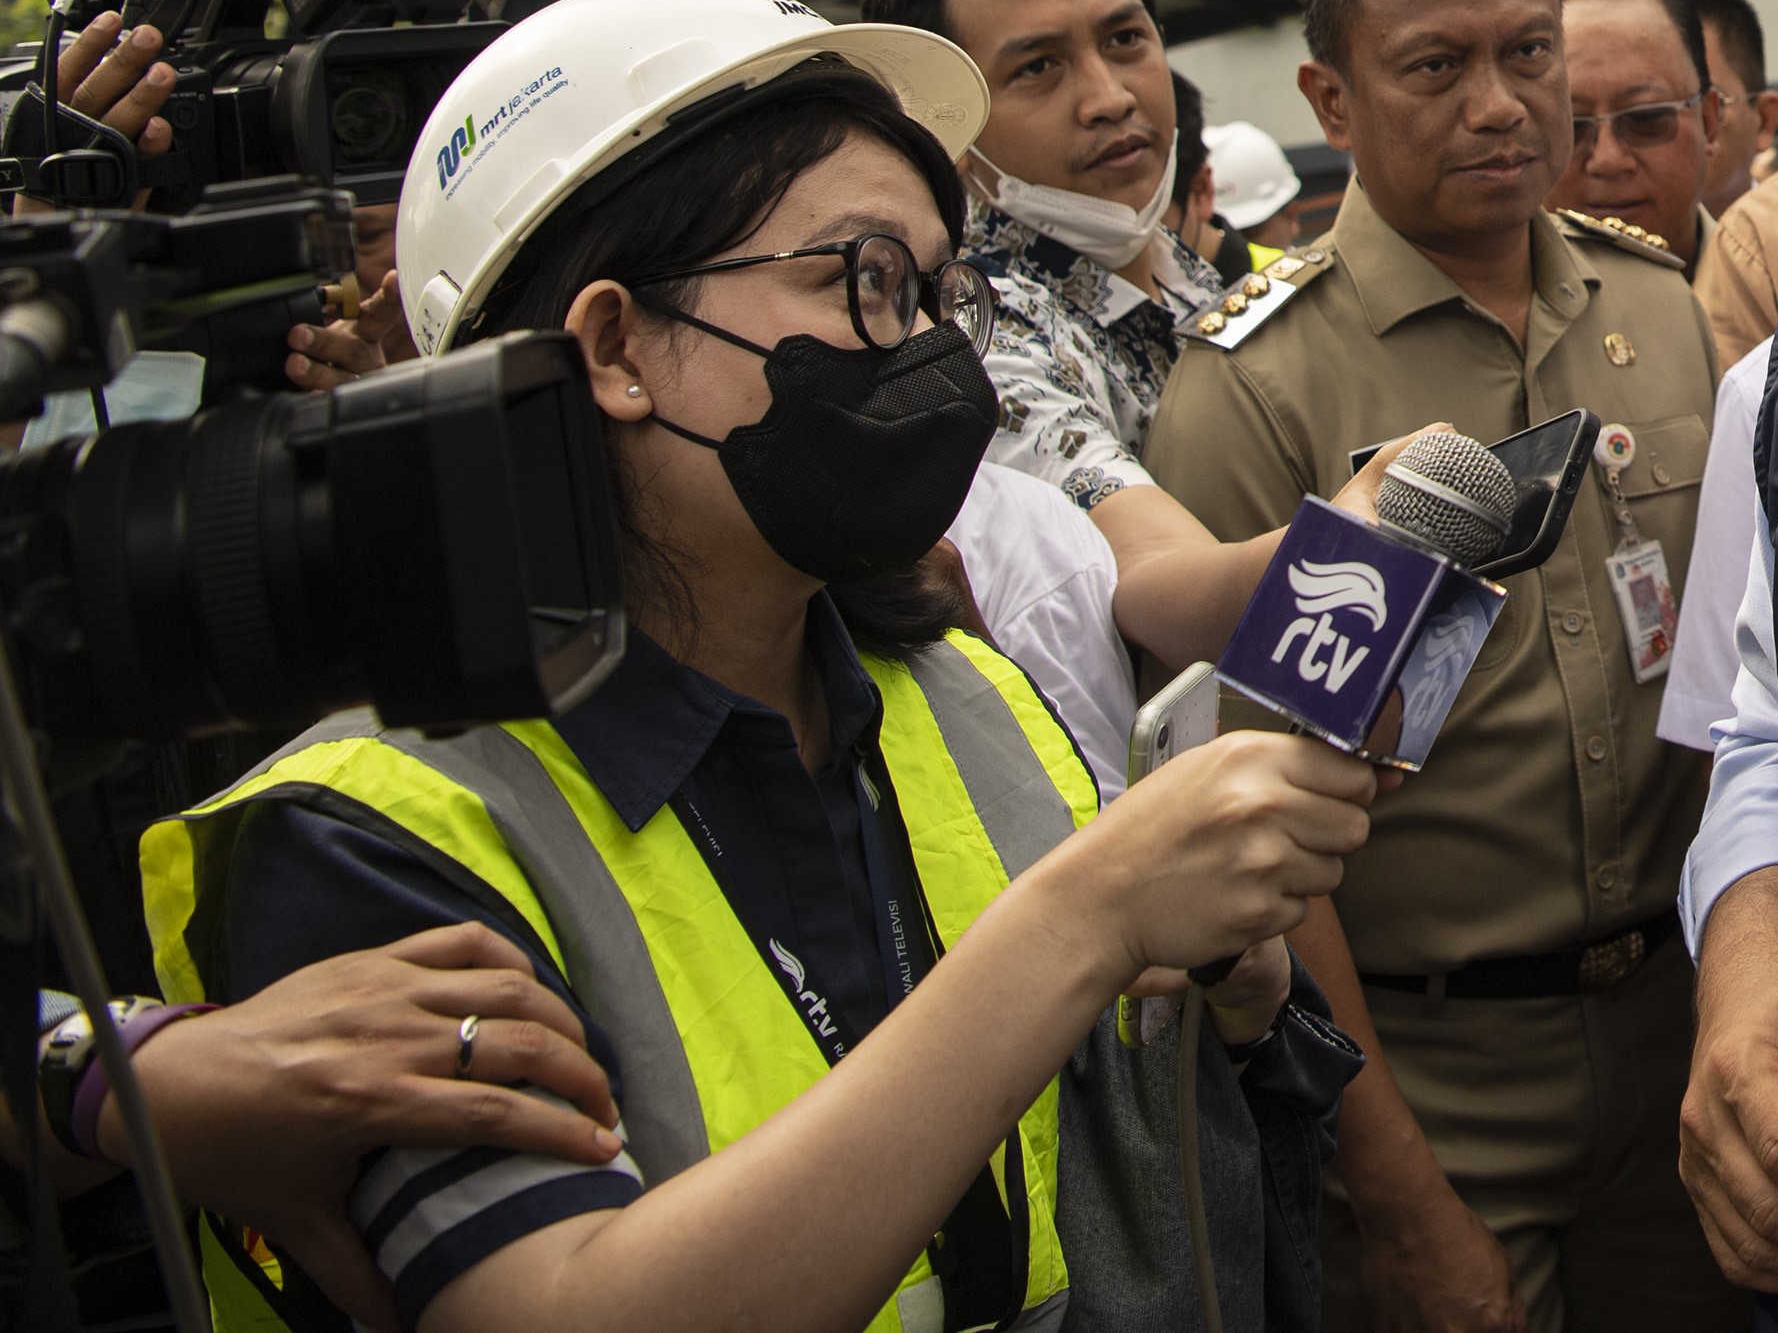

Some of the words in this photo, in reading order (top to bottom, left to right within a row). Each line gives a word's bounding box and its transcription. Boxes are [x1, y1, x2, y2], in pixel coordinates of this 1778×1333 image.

[445, 164, 474, 202] increasing
[529, 96, 543, 109] life
[542, 78, 570, 99] quality
[479, 105, 508, 140] mrt
[508, 66, 564, 116] jakarta
[1270, 611, 1371, 695] rtv
[888, 899, 909, 960] TELEVISI
[799, 990, 839, 1038] rtv
